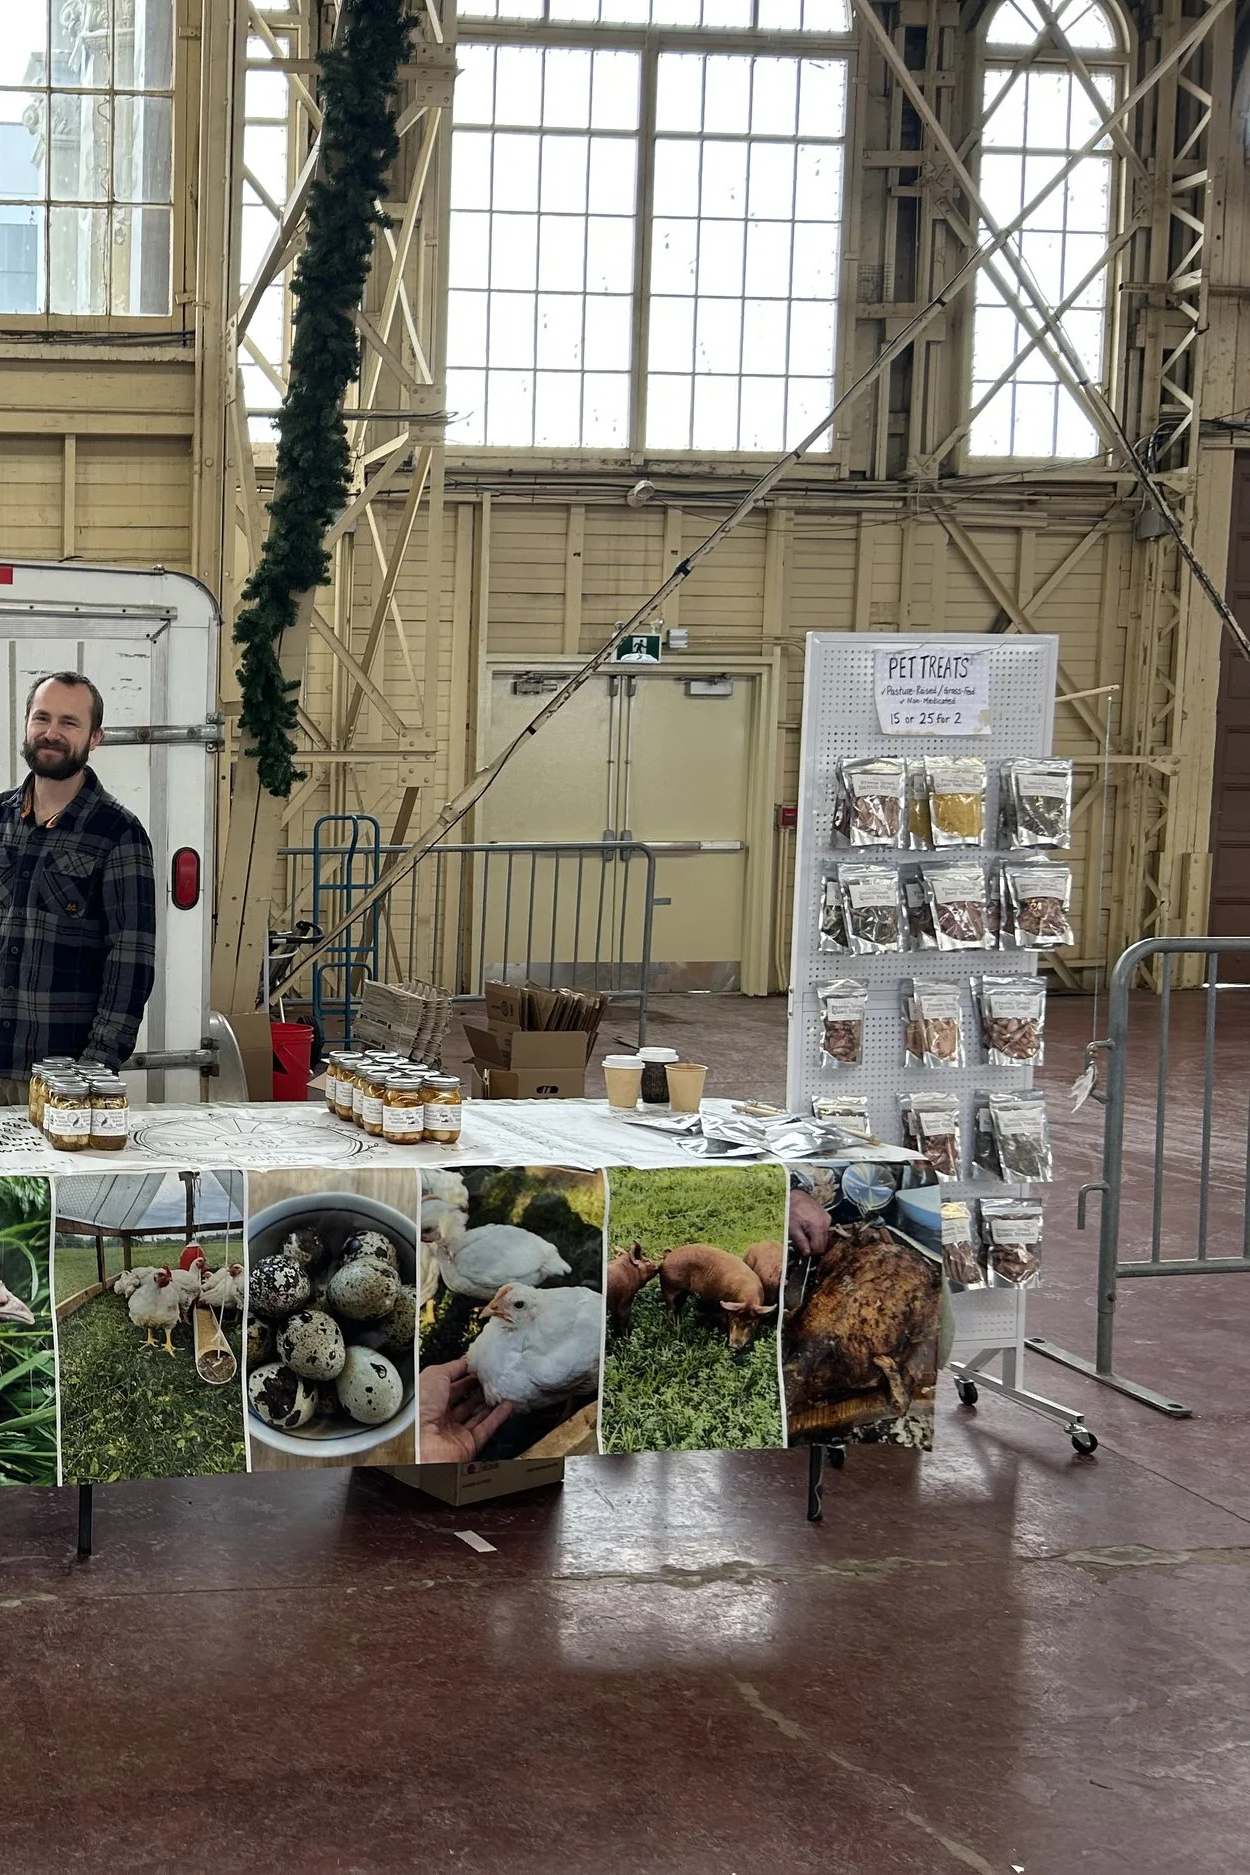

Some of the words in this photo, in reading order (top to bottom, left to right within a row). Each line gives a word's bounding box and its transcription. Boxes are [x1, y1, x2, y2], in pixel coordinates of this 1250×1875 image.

[888, 656, 916, 679] PET
[920, 655, 970, 679] TREATS
[890, 712, 900, 725] 15
[905, 716, 914, 724] or
[919, 712, 934, 724] 25
[936, 713, 950, 724] for
[954, 712, 962, 724] 2
